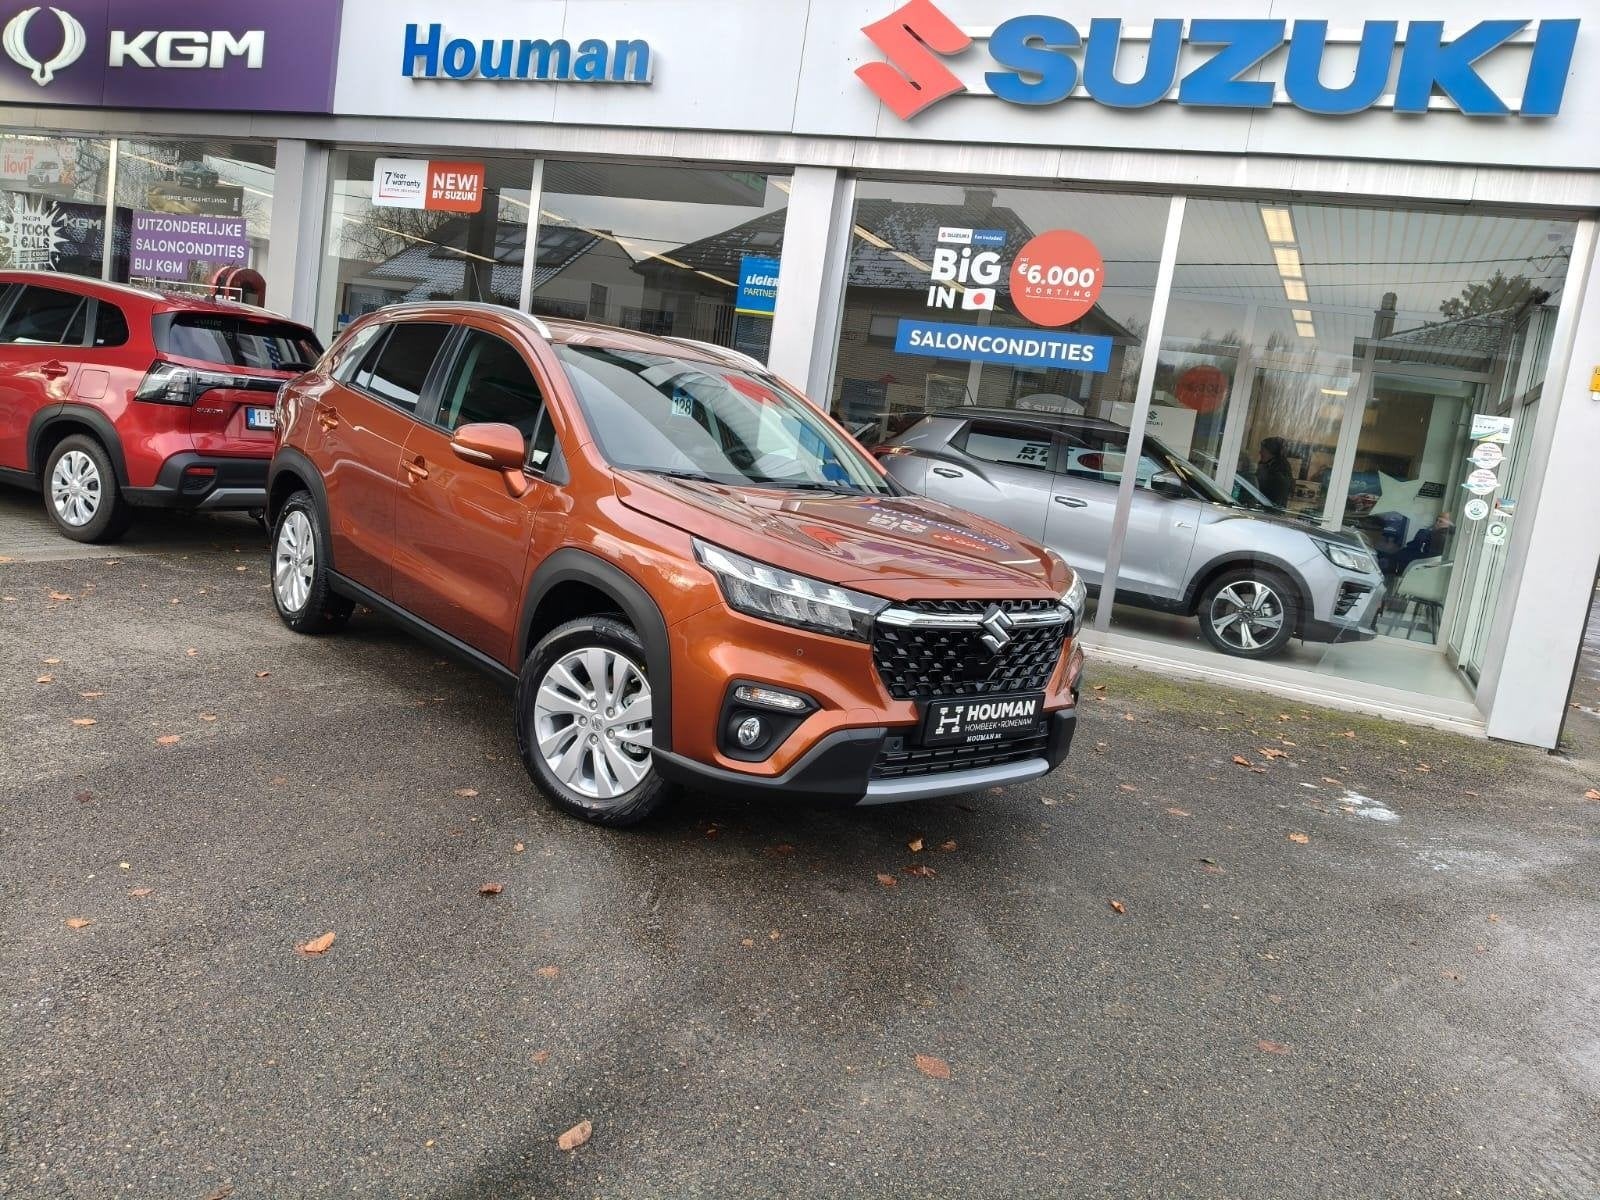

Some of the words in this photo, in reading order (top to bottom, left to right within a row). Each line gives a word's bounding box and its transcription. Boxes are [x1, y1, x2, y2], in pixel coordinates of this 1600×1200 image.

[109, 30, 265, 69] KGM
[401, 23, 653, 83] Houman
[984, 14, 1582, 118] SUZUKI
[384, 171, 392, 185] 7
[393, 171, 407, 179] Year
[392, 179, 421, 189] warranty
[433, 172, 479, 191] NEW!
[432, 190, 443, 199] BY
[444, 190, 477, 201] SUZUKI
[136, 218, 242, 237] UITZONDERLIJKE
[135, 238, 245, 259] SALONCONDITIES
[134, 258, 153, 271] BIJ
[156, 259, 183, 274] KGM
[927, 285, 956, 309] IN
[1025, 286, 1092, 298] KORTING
[908, 329, 1095, 363] SALONCONDITIES
[966, 699, 1036, 722] HOUMAN
[964, 721, 997, 732] HOMBEEK
